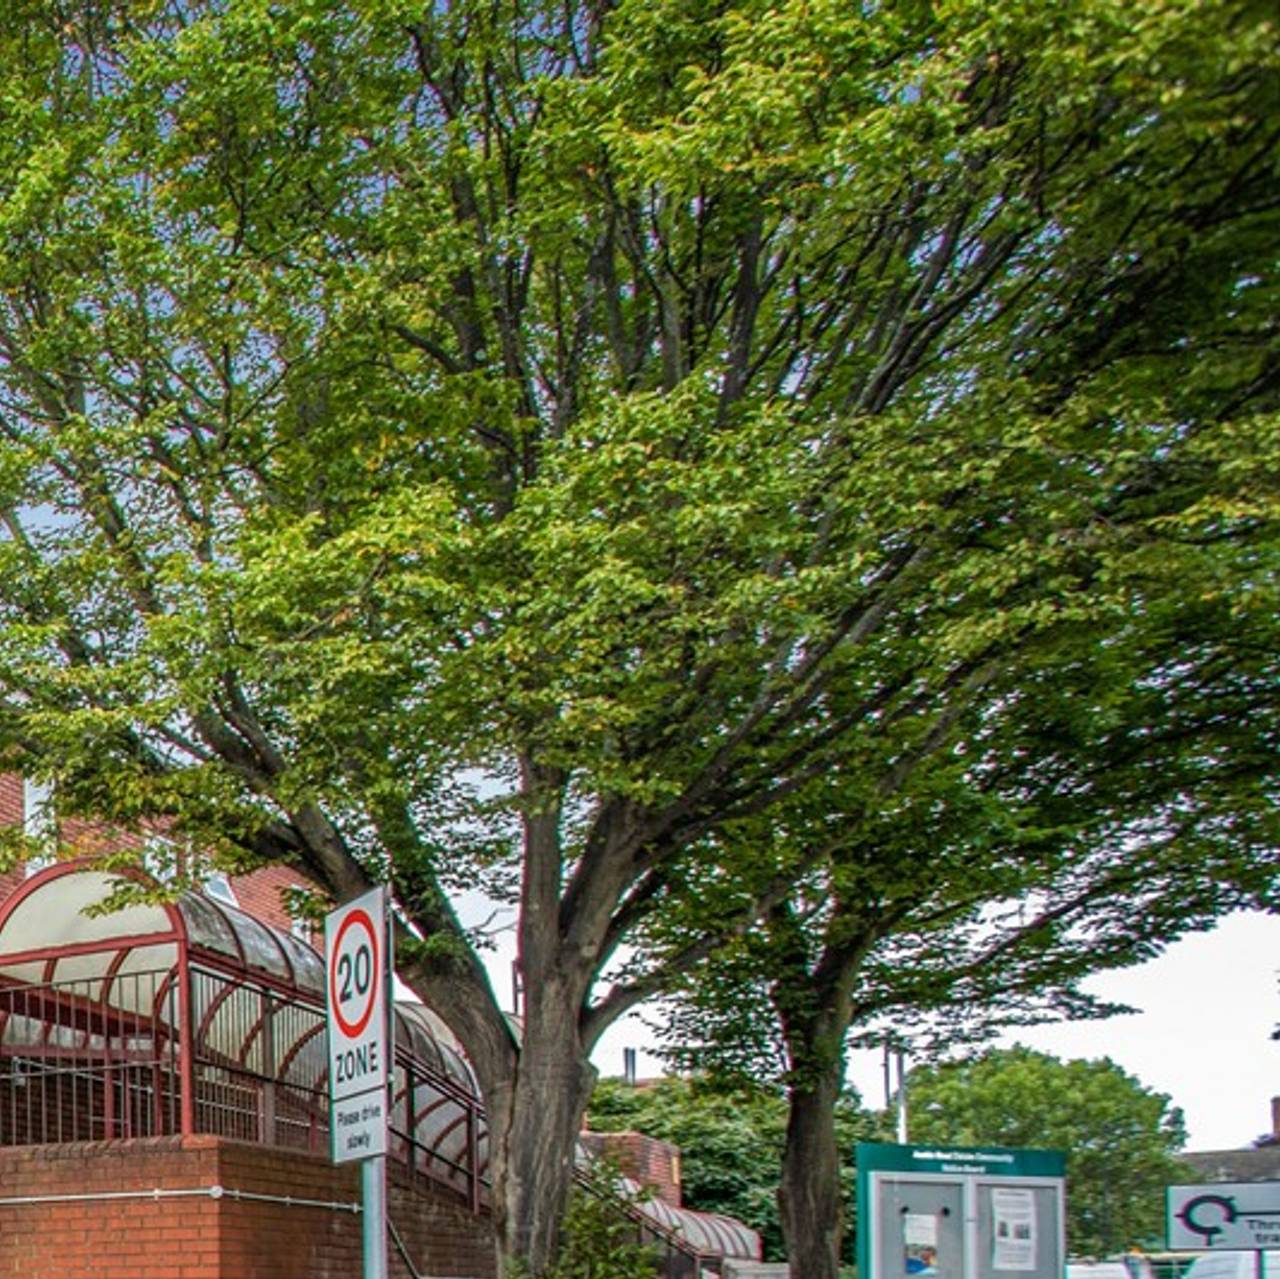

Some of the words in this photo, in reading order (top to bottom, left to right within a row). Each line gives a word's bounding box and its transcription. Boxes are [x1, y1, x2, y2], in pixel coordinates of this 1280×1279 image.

[337, 945, 370, 1004] 20
[336, 1041, 378, 1083] ZONE
[337, 1111, 360, 1128] Please
[361, 1103, 381, 1122] drive
[346, 1130, 370, 1151] slowly
